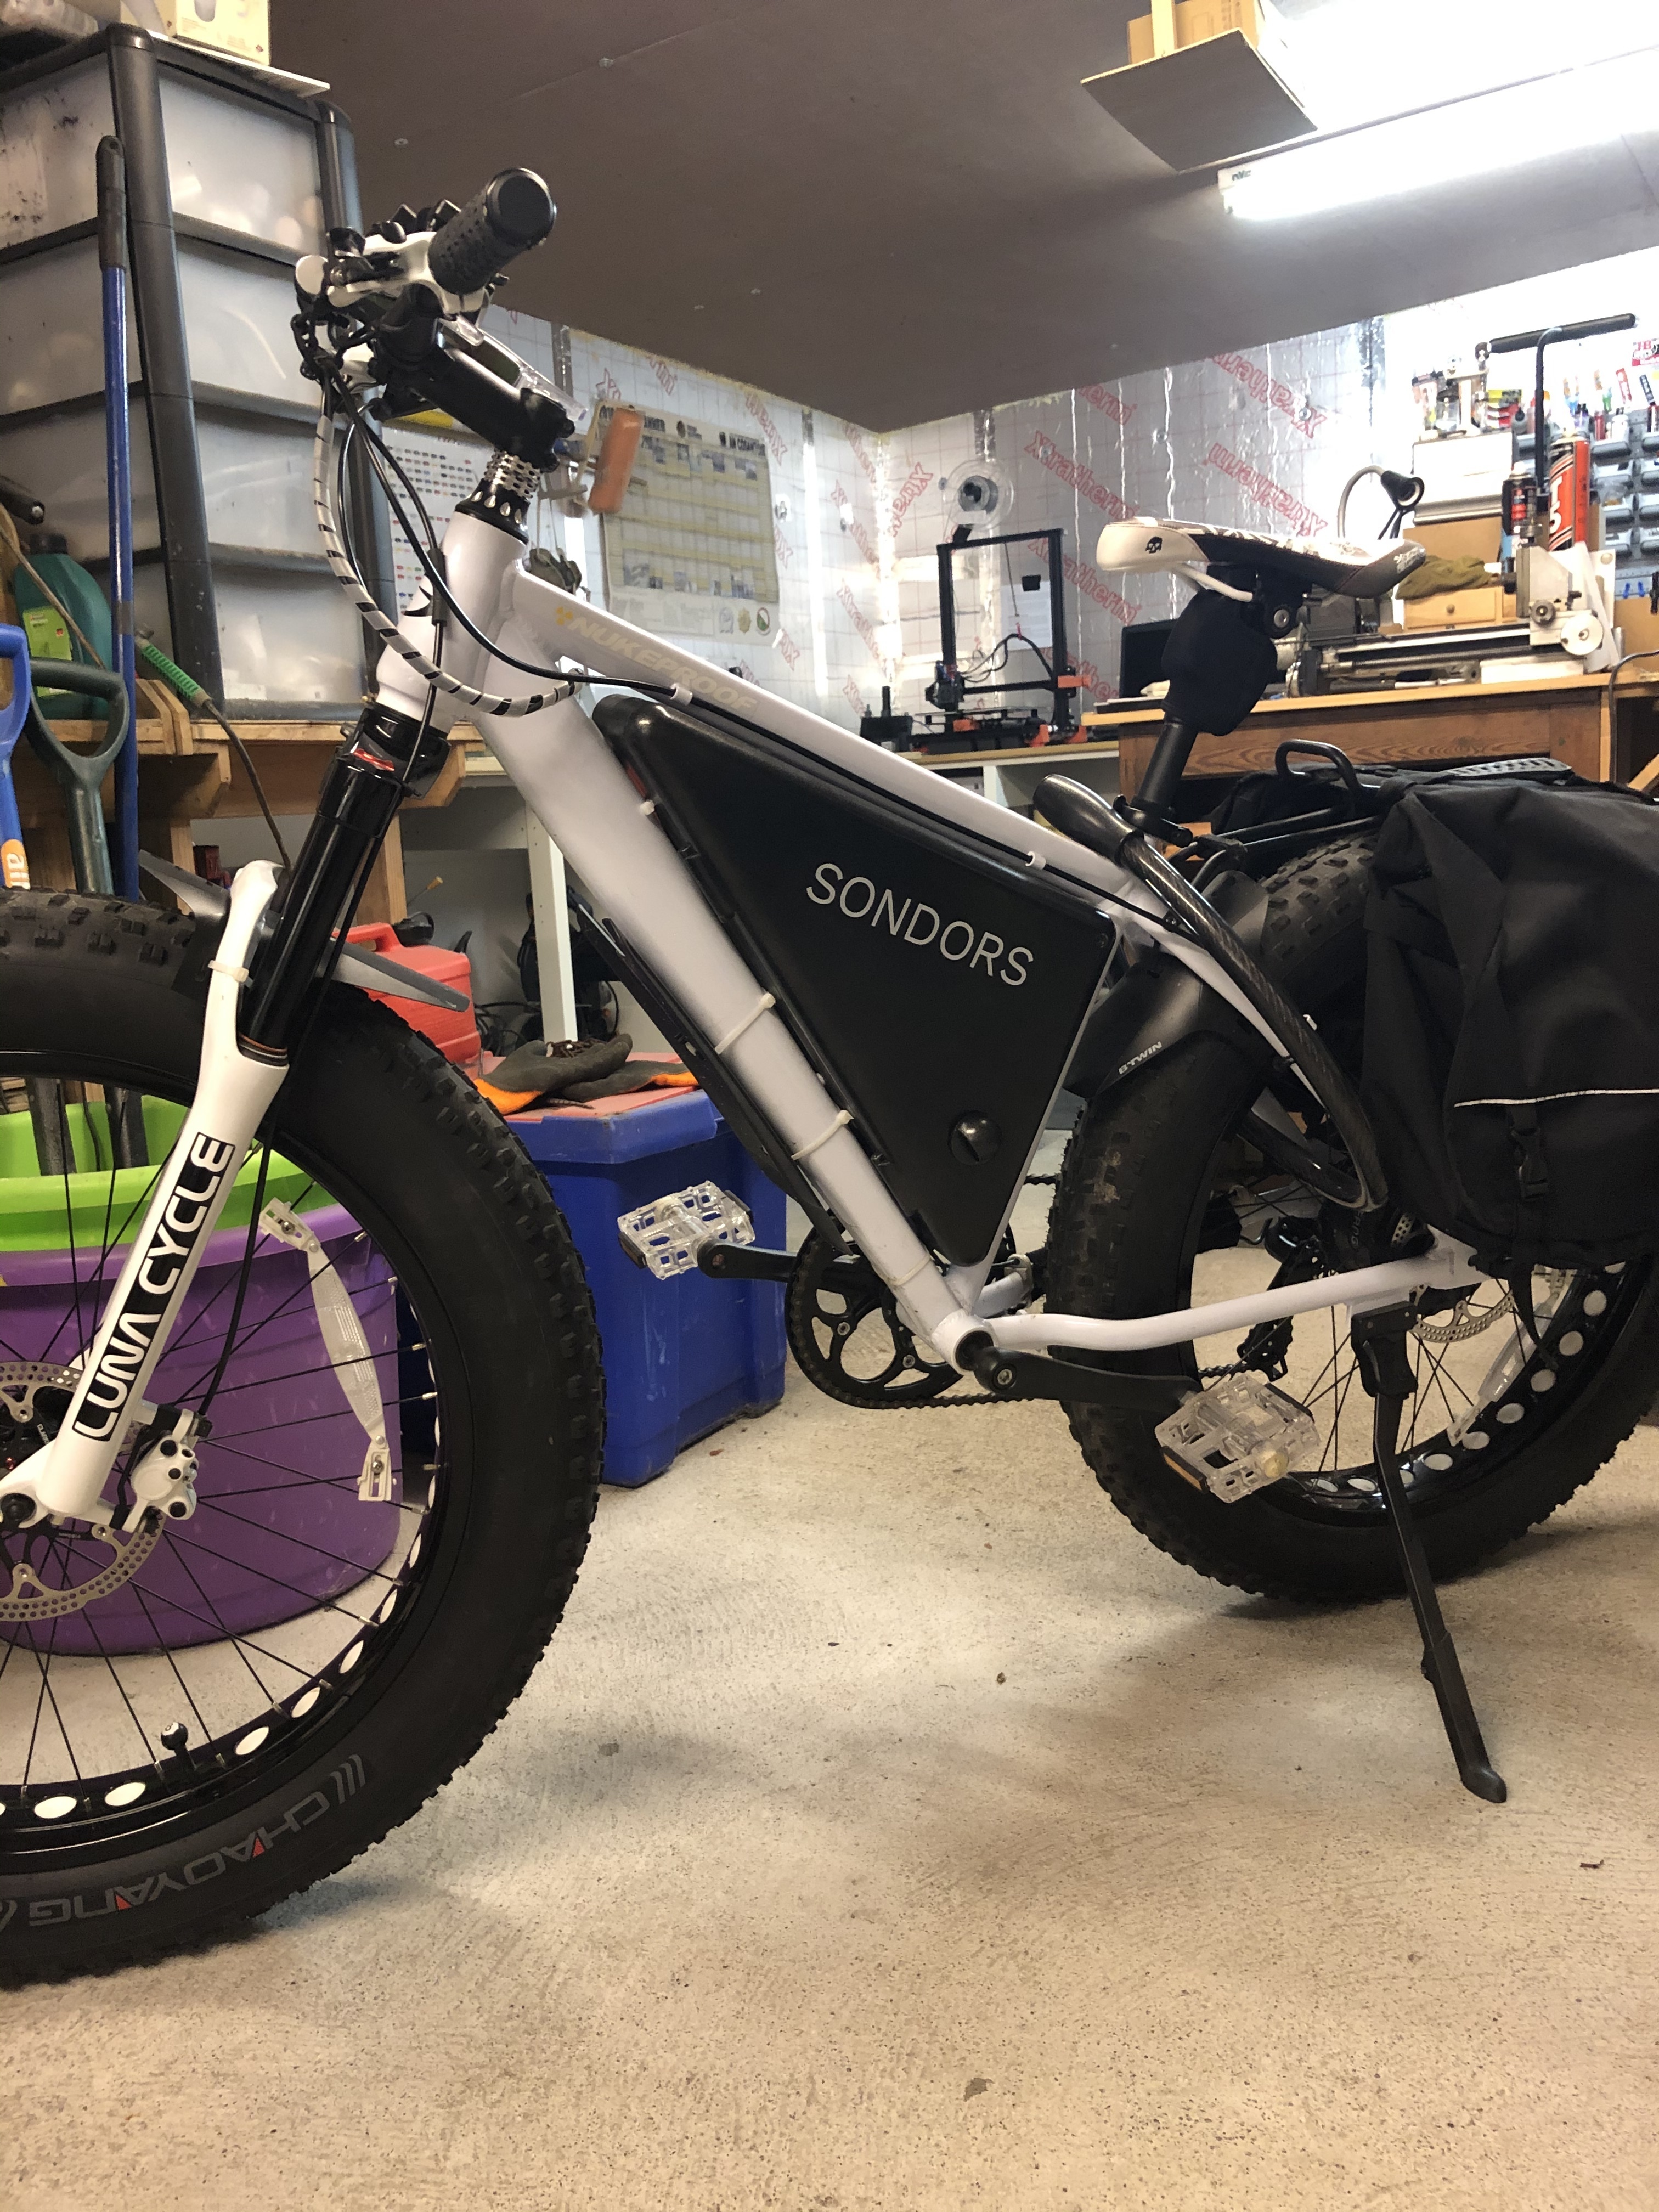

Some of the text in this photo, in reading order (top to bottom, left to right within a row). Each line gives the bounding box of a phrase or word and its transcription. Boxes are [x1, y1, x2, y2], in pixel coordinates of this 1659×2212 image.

[567, 617, 759, 711] NUKEPROOF
[806, 863, 1034, 986] SONDORS
[1119, 1041, 1162, 1074] BTWIN
[75, 1135, 233, 1439] LUNA CYCLE
[30, 1791, 329, 1926] CHAOYANG
